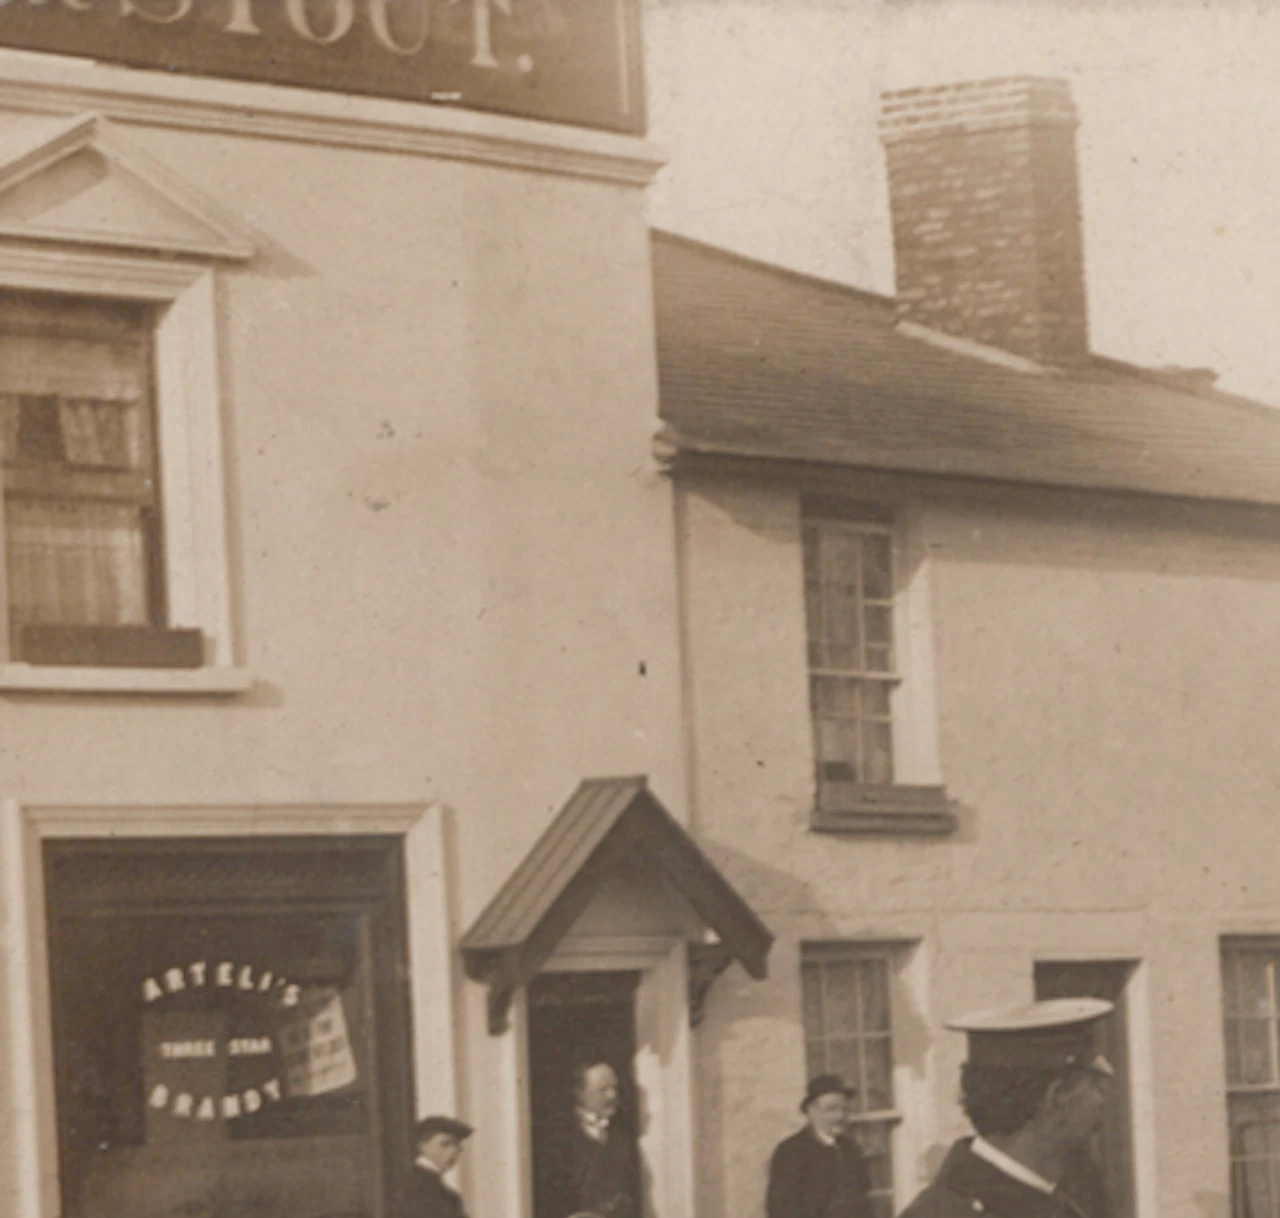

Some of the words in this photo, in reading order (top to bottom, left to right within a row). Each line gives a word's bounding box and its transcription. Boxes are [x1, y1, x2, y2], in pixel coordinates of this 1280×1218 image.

[121, 0, 533, 73] OUT.
[228, 1037, 272, 1056] STAR
[149, 1079, 281, 1121] BRANDY
